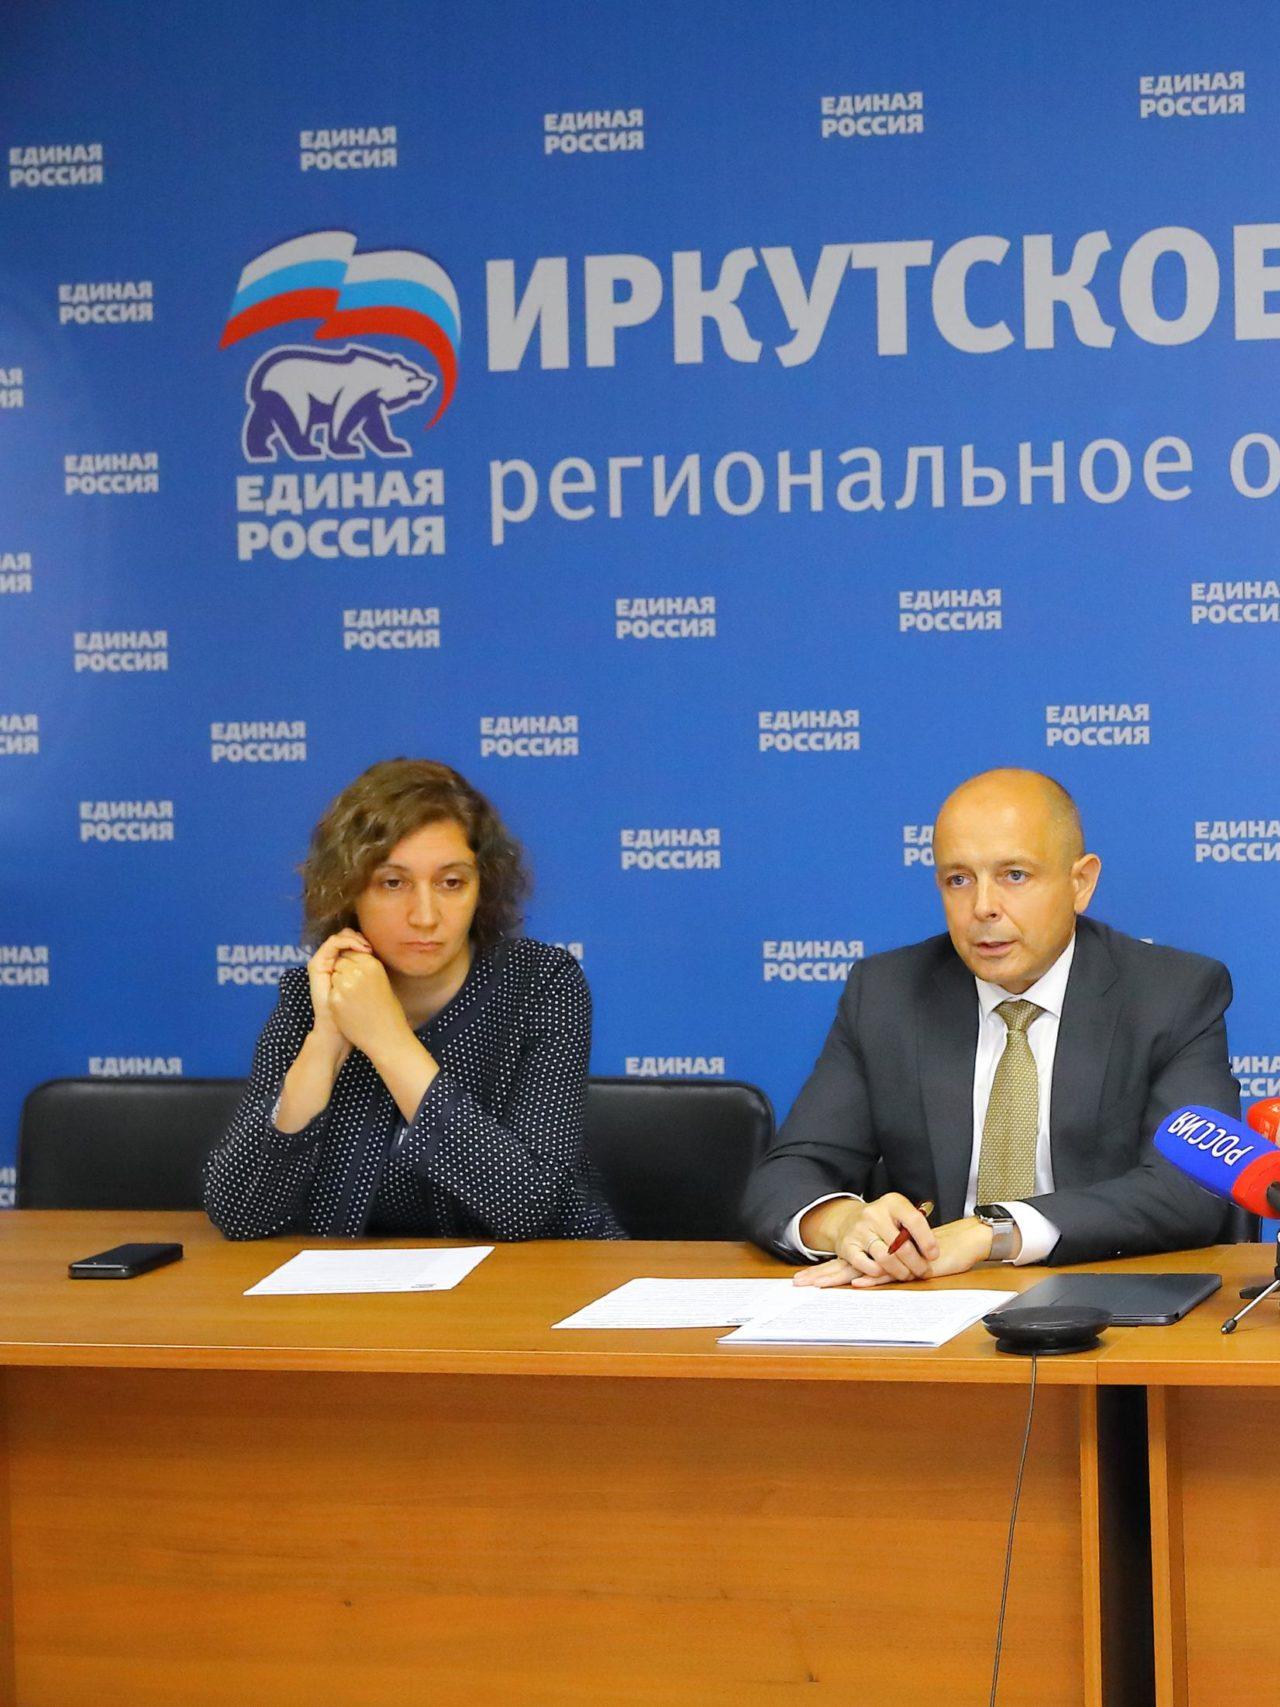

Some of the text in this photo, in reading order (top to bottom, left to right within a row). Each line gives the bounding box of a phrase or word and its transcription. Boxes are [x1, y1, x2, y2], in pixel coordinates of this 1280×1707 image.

[1140, 72, 1244, 96] ЕДИНАЯ
[821, 92, 923, 116] ЕДИНАЯ
[1141, 94, 1245, 118] РОССИЯ
[544, 109, 643, 133] ЕДИНАЯ
[822, 114, 923, 138] РОССИЯ
[300, 127, 396, 150] ЕДИНАЯ
[545, 131, 644, 154] РОССИЯ
[9, 144, 102, 168] ЕДИНАЯ
[301, 148, 397, 171] РОССИЯ
[10, 165, 103, 187] РОССИЯ
[59, 281, 153, 304] ЕДИНАЯ
[60, 302, 153, 324] РОССИЯ
[64, 453, 158, 476] ЕДИНАЯ
[65, 474, 158, 495] РОССИЯ
[237, 470, 444, 516] ЕДИНАЯ
[488, 432, 1195, 547] региональное
[238, 516, 445, 560] РОССИЯ
[616, 597, 715, 618] ЕДИНАЯ
[900, 589, 1001, 610] ЕДИНАЯ
[344, 608, 439, 629] ЕДИНАЯ
[616, 618, 716, 639] РОССИЯ
[900, 611, 1002, 631] РОССИЯ
[74, 631, 167, 652] ЕДИНАЯ
[344, 629, 440, 649] РОССИЯ
[74, 652, 168, 672] РОССИЯ
[759, 710, 859, 731] ЕДИНАЯ
[1046, 704, 1149, 725] ЕДИНАЯ
[211, 721, 306, 742] ЕДИНАЯ
[481, 716, 578, 736] ЕДИНАЯ
[1047, 726, 1149, 746] РОССИЯ
[212, 742, 306, 762] РОССИЯ
[481, 737, 578, 757] РОССИЯ
[760, 732, 860, 751] РОССИЯ
[80, 801, 173, 821] ЕДИНАЯ
[80, 821, 173, 841] РОССИЯ
[621, 829, 720, 849] ЕДИНАЯ
[622, 850, 720, 869] РОССИЯ
[763, 940, 864, 962] ЕДИНАЯ
[217, 966, 286, 985] РОСС
[763, 962, 853, 982] РОССИ
[88, 1057, 183, 1076] ЕДИНАЯ
[625, 1057, 726, 1077] ЕДИНАЯ
[1167, 1111, 1255, 1167] РОССИЯ
